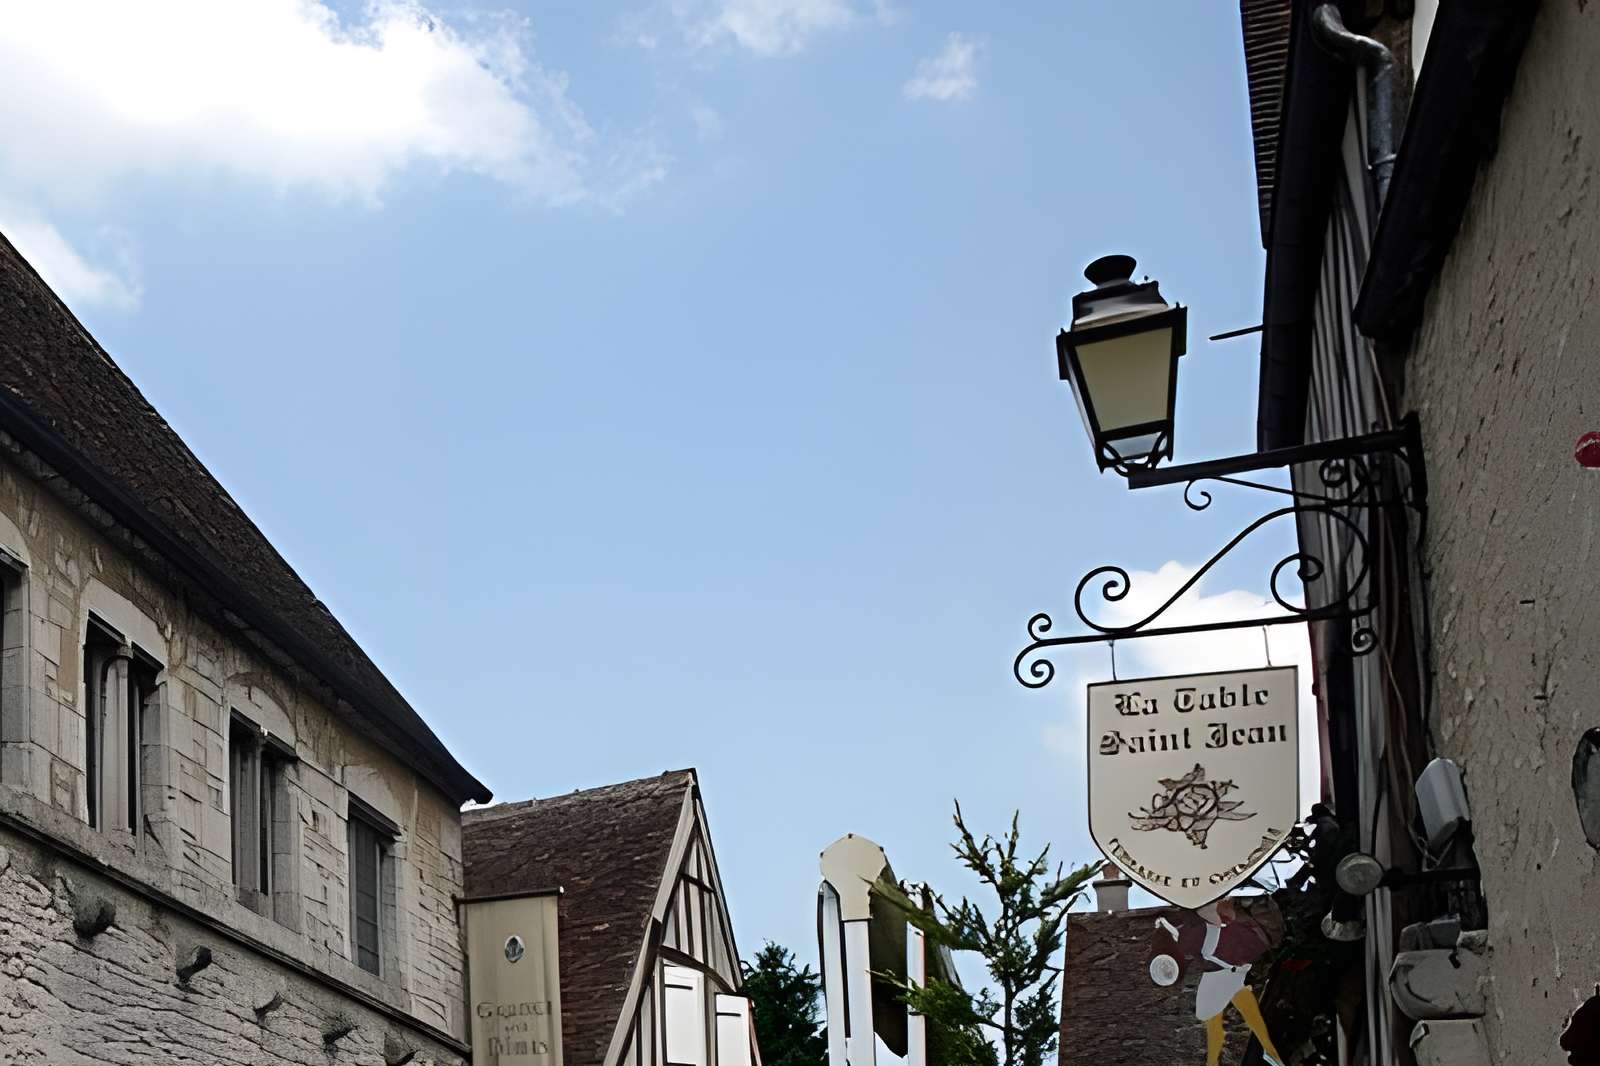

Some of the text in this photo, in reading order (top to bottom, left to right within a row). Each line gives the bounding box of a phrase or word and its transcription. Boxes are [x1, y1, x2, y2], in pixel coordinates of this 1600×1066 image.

[1114, 683, 1269, 716] La Table
[1099, 722, 1287, 755] Saint Jean
